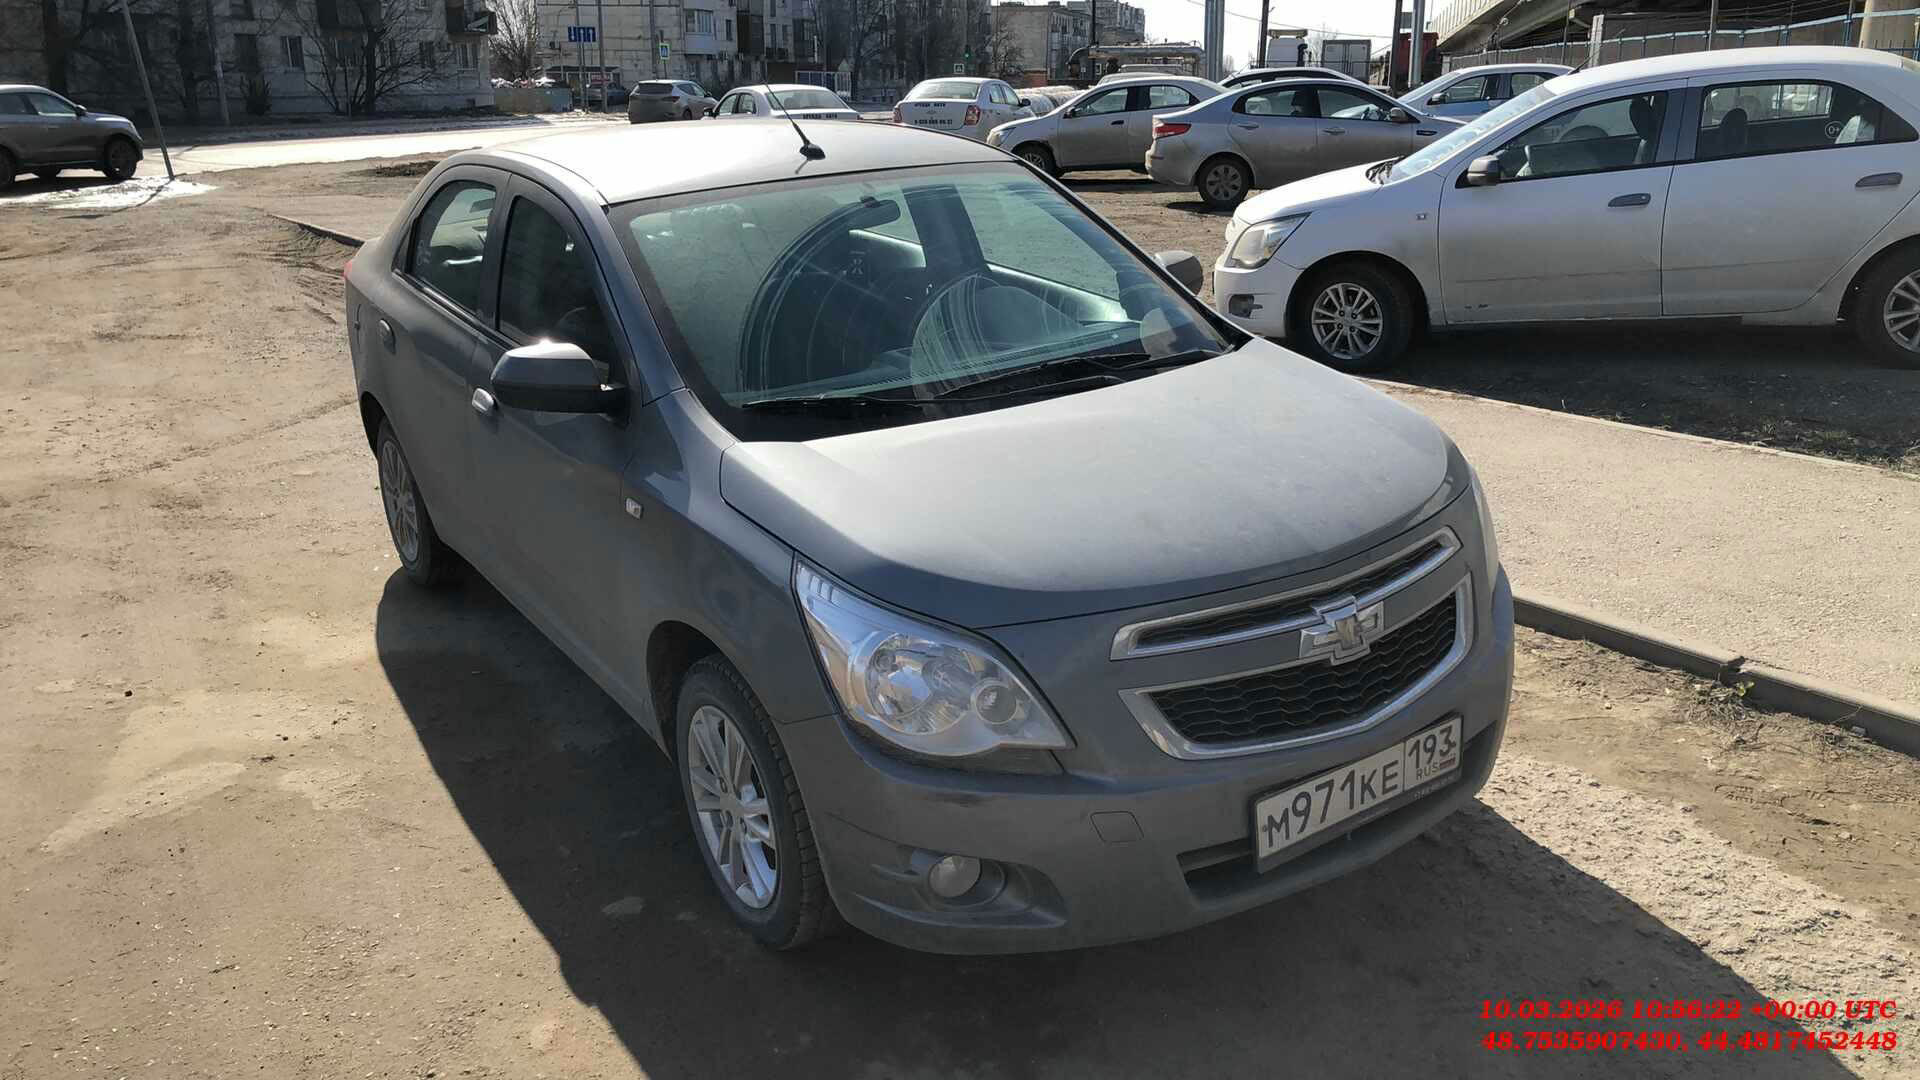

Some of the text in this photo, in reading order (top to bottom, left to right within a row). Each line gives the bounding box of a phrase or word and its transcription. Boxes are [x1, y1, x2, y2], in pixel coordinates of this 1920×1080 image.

[1266, 725, 1457, 848] М971КЕ 193
[1416, 762, 1439, 781] RUS
